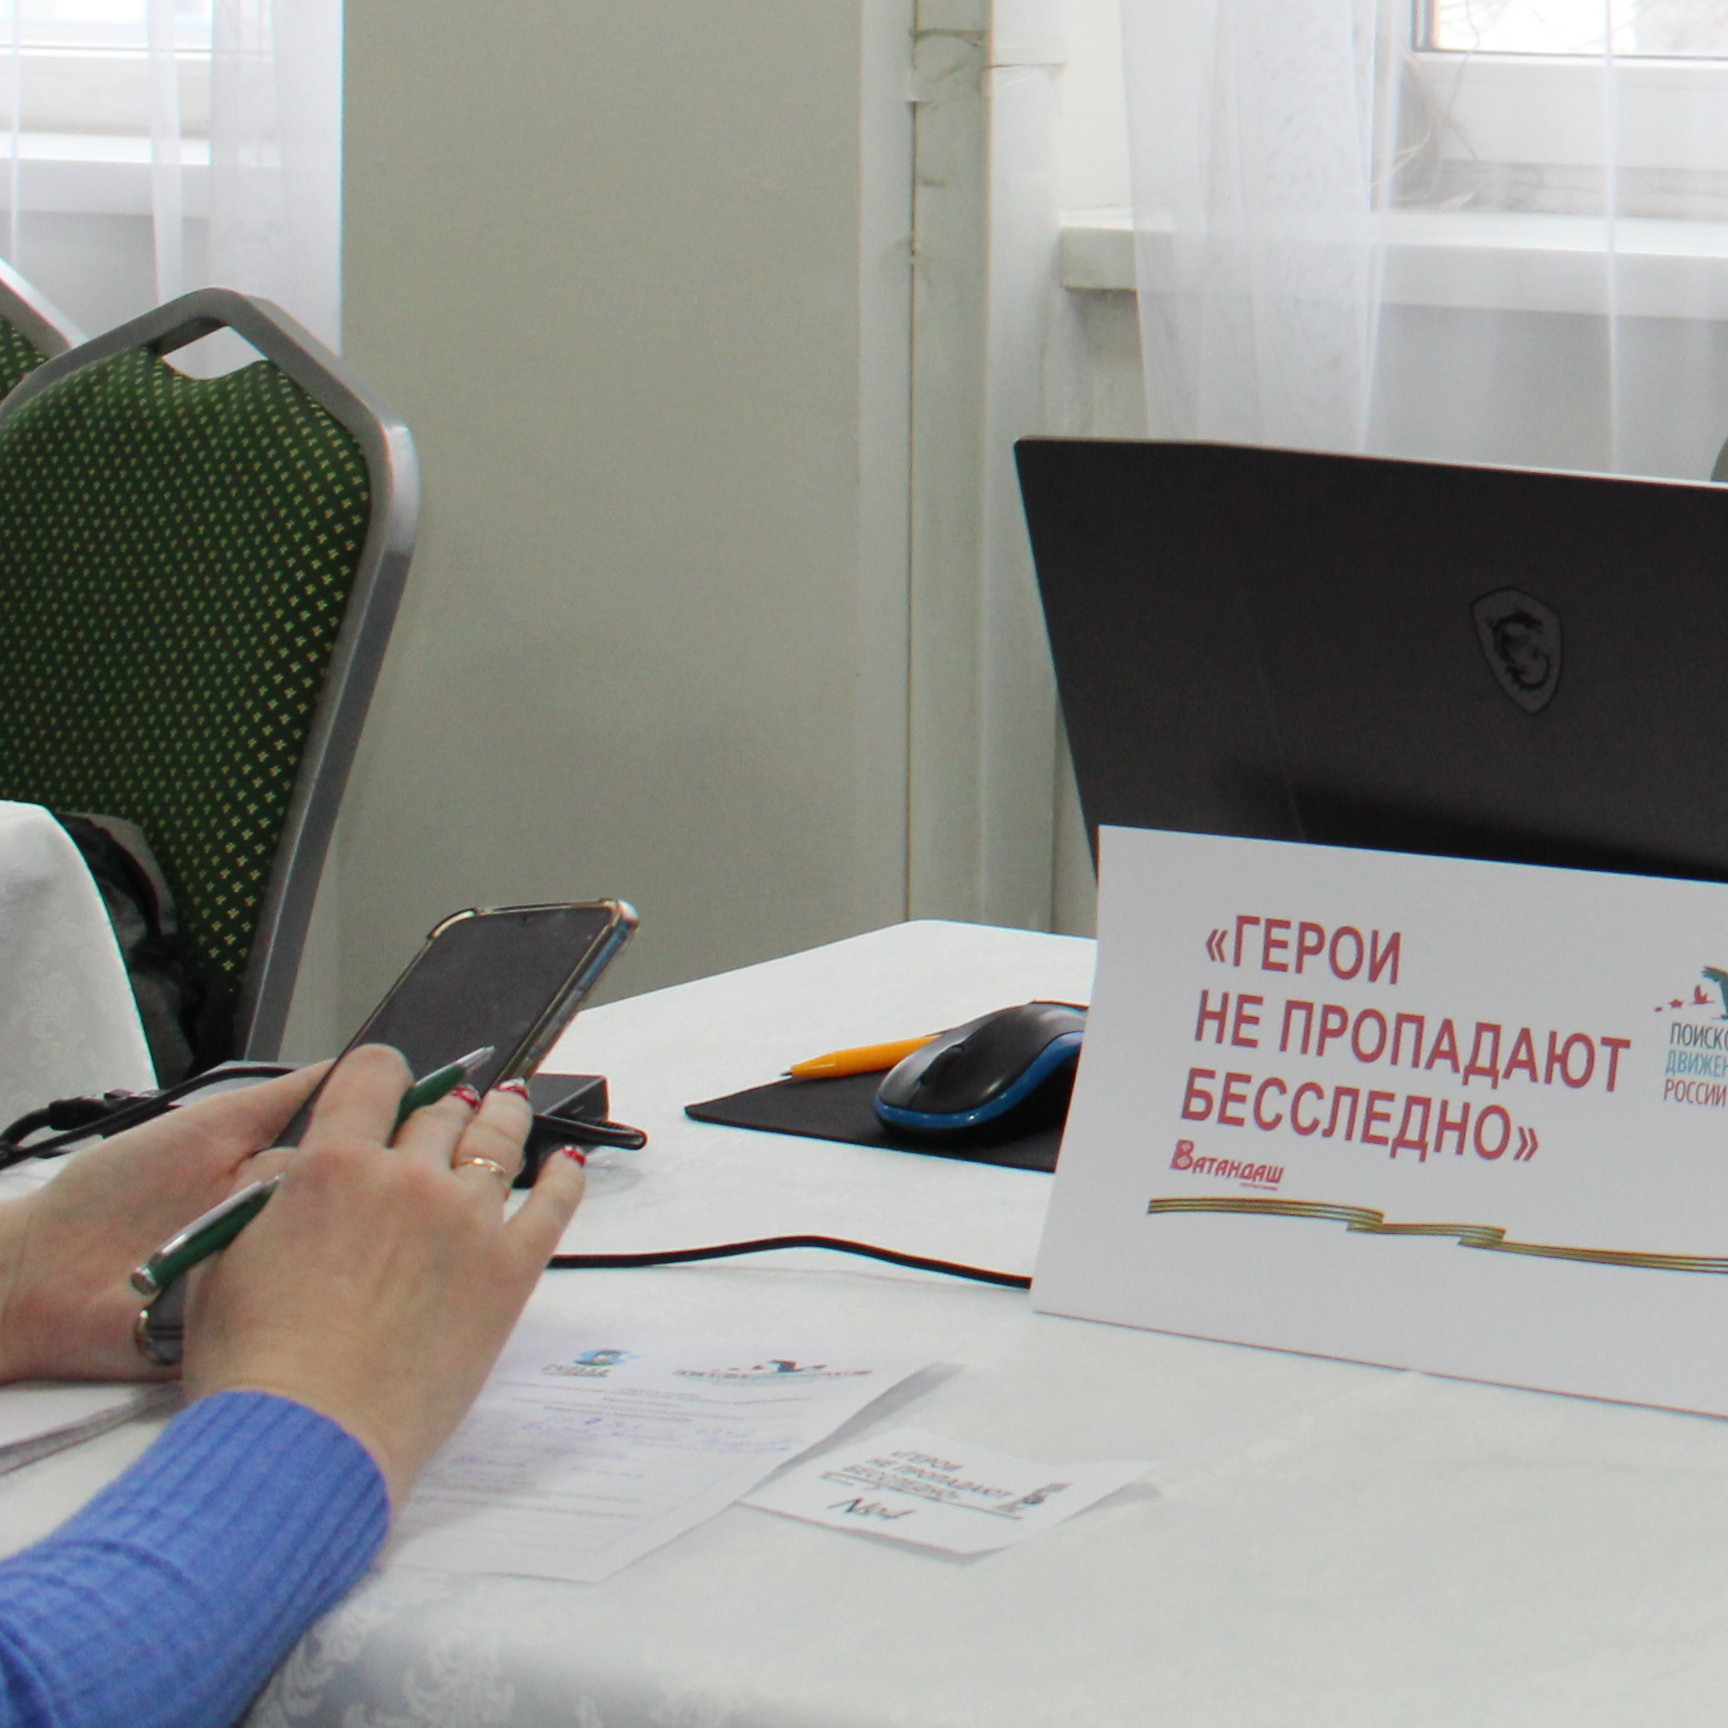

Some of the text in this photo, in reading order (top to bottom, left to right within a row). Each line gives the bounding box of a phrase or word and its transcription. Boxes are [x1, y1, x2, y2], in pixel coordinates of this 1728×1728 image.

[1205, 913, 1402, 985] «ГЕРОИ
[1195, 990, 1631, 1093] НЕ ПРОПАДАЮТ
[1180, 1067, 1539, 1164] БЕССЛЕДНО»
[1664, 1079, 1728, 1108] РОССИИ
